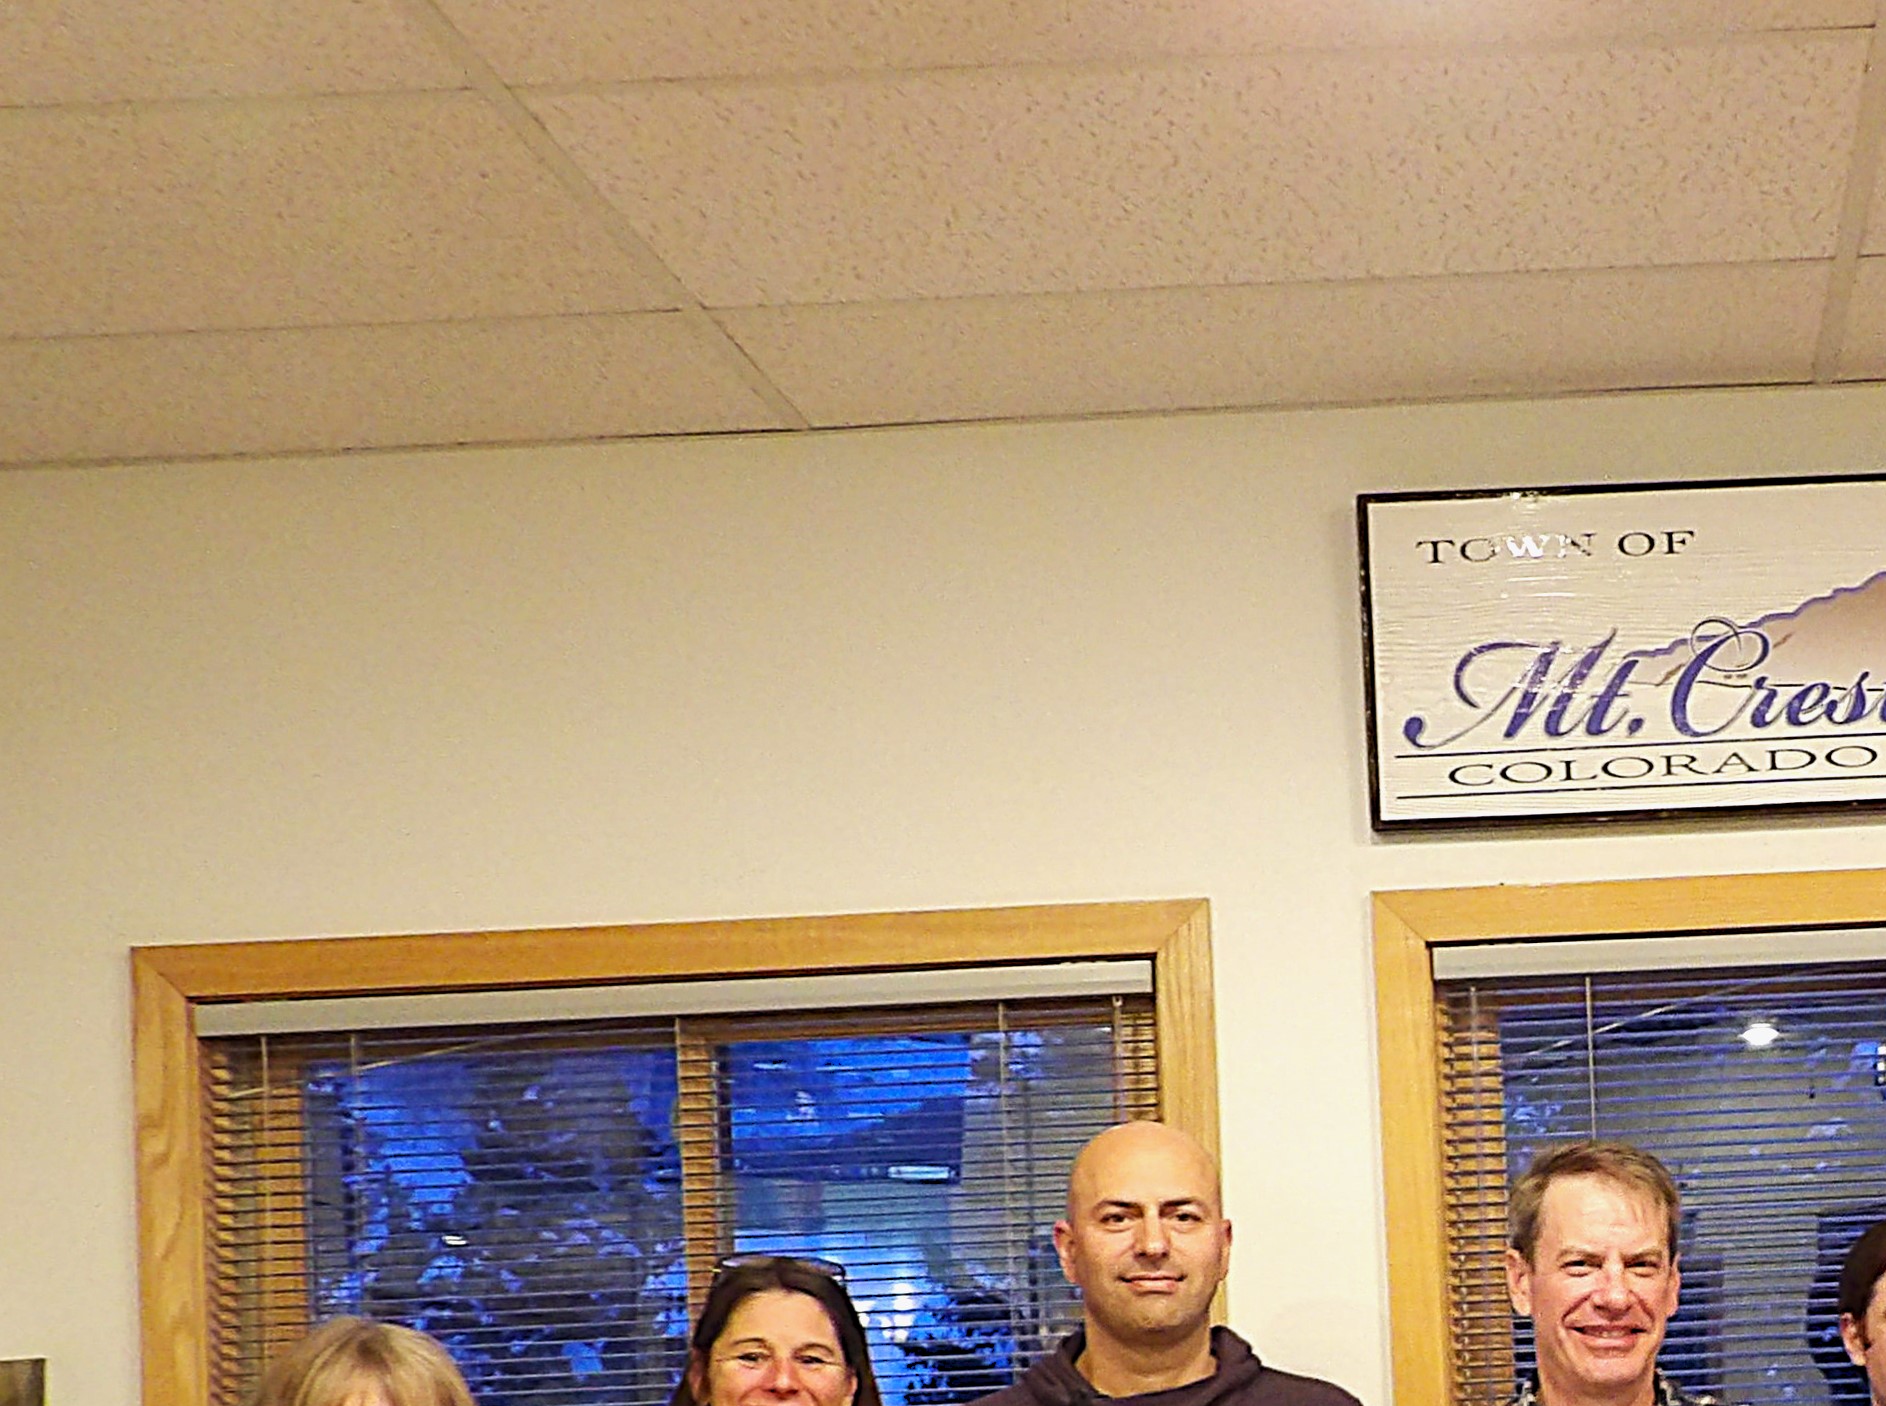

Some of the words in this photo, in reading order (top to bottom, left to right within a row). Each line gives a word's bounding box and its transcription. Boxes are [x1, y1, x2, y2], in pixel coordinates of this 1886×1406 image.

[1415, 531, 1598, 565] TOWN
[1617, 530, 1696, 558] OF
[1403, 627, 1646, 750] Mt.
[1447, 744, 1878, 786] COLORADO
